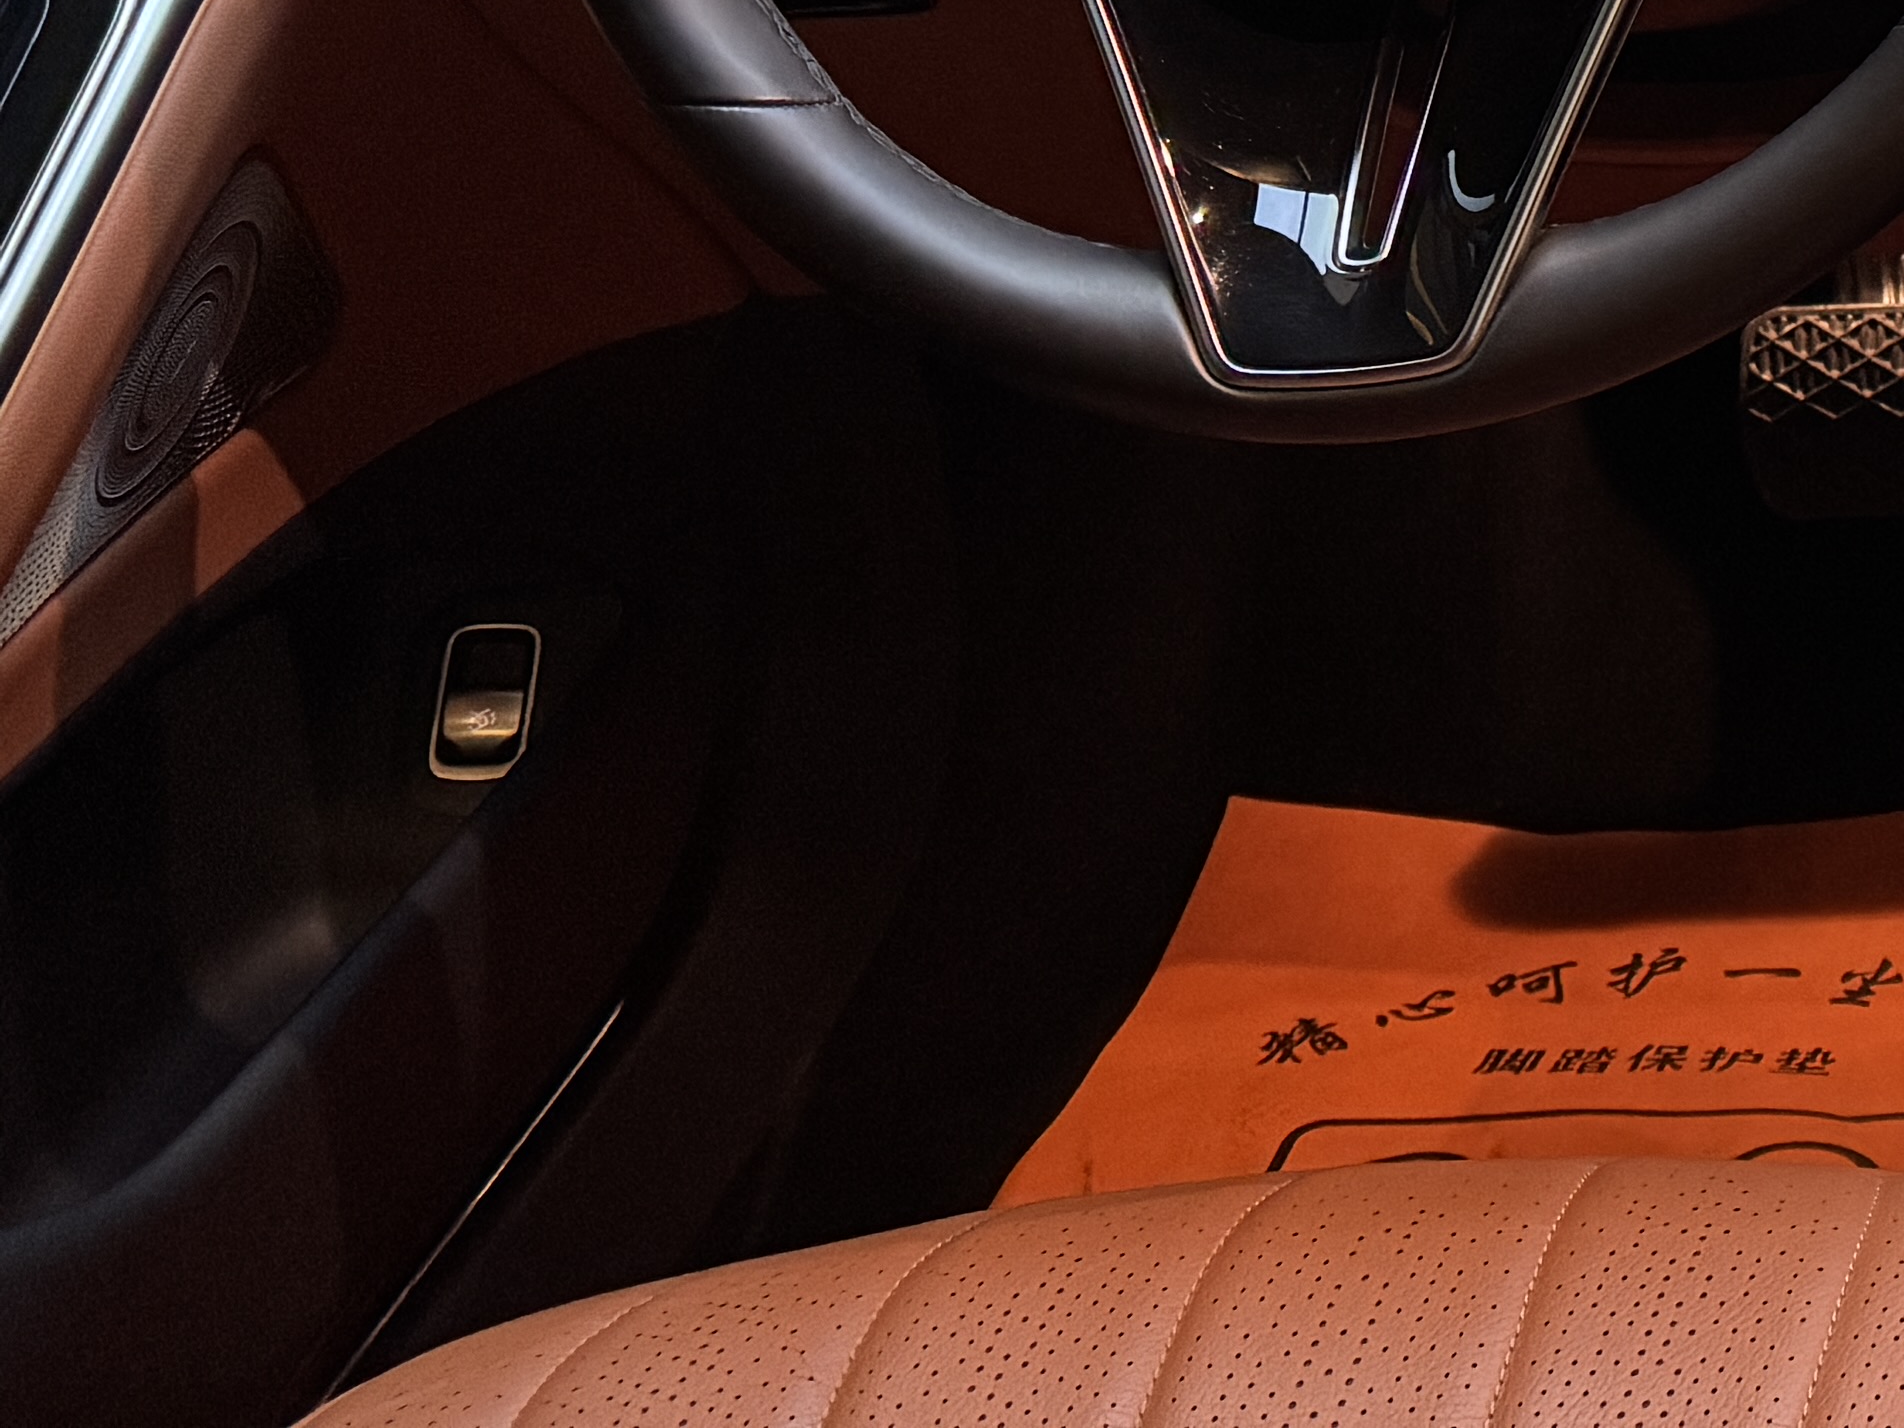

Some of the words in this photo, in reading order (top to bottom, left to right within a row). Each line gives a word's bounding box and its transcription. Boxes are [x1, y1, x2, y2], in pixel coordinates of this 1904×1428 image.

[1473, 1044, 1836, 1076] 脚踏保护垫
